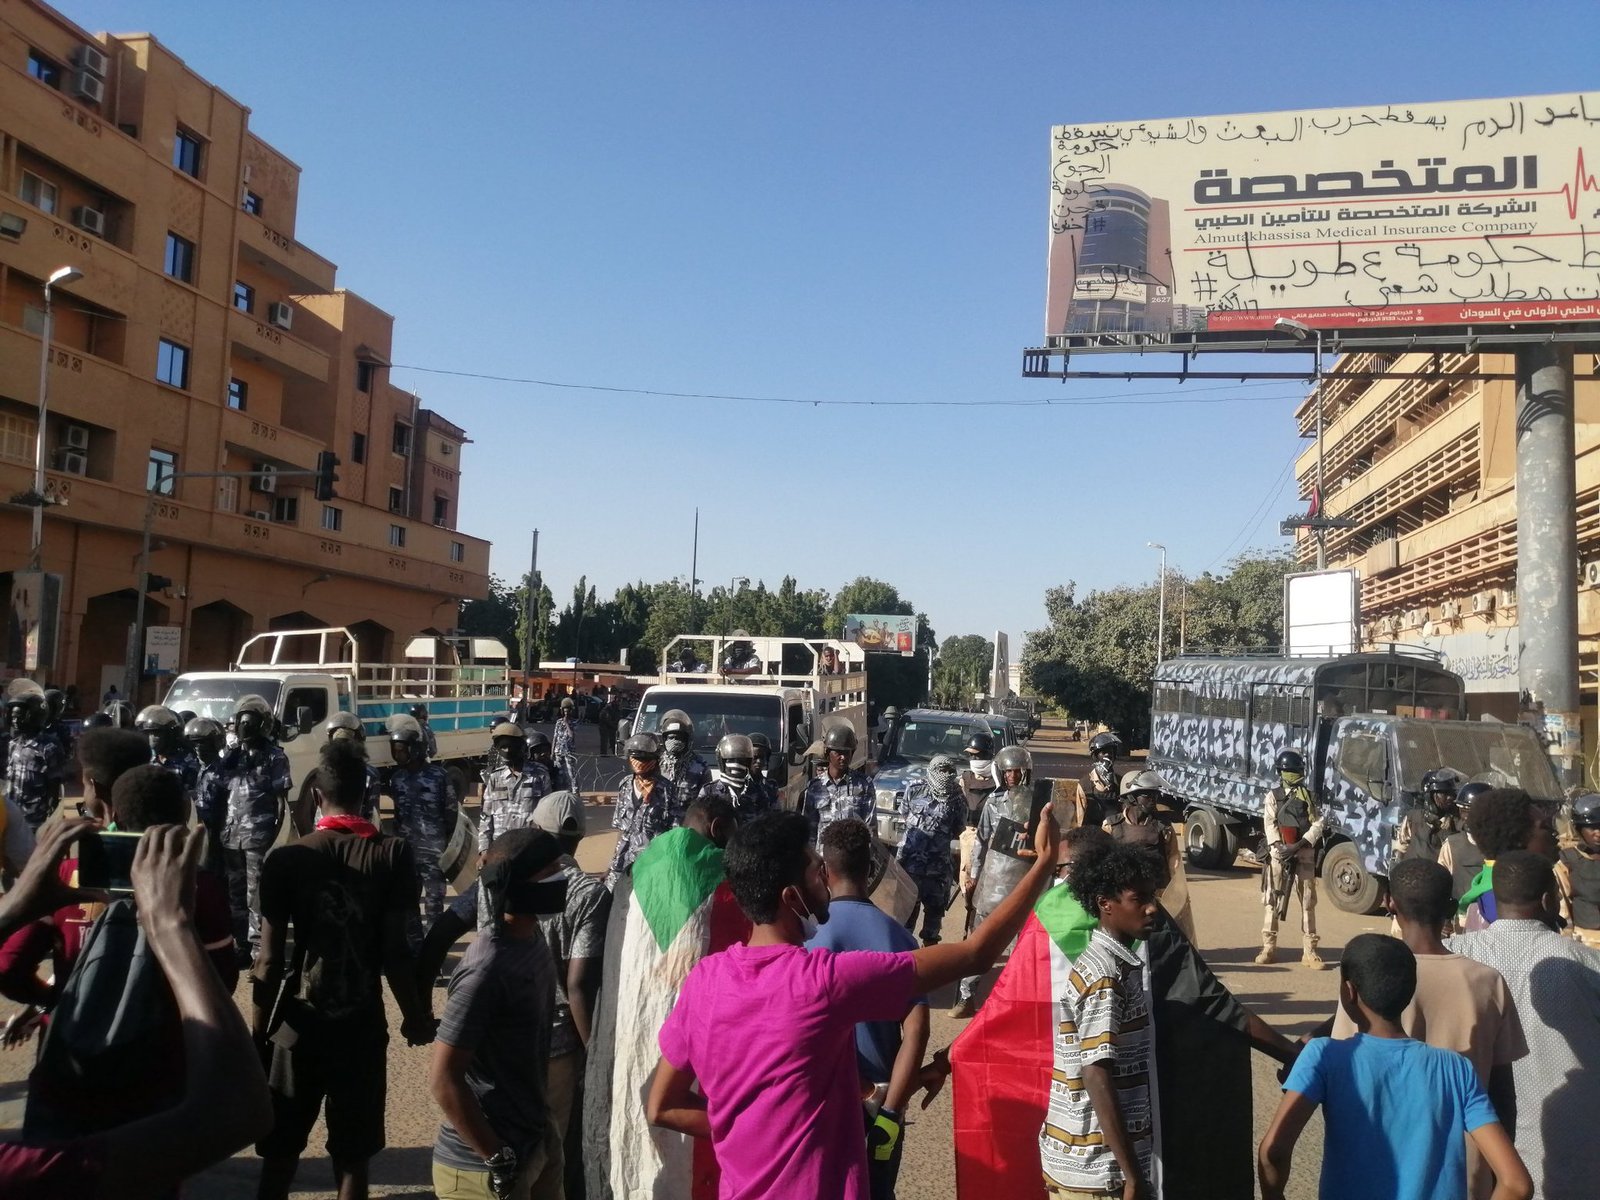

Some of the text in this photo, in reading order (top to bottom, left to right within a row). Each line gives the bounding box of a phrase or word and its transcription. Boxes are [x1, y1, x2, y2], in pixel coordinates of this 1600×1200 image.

[1216, 116, 1303, 146] البعث
[1379, 105, 1446, 131] يسقط
[1462, 101, 1524, 150] الدم
[1053, 154, 1111, 184] الجوع
[1194, 155, 1538, 204] المتخصصة
[1194, 198, 1537, 231] الشركة المتخصصة للتأمين الطبي
[1194, 221, 1538, 244] Almutakhassisa Medical Insurance Company
[1207, 231, 1357, 294] طويلة
[1395, 231, 1561, 278] حكومة
[1151, 296, 1172, 304] 2627
[1459, 307, 1501, 319] السودان
[1503, 307, 1527, 321] في
[1528, 304, 1558, 319] الأولى
[1559, 305, 1595, 319] الطبي
